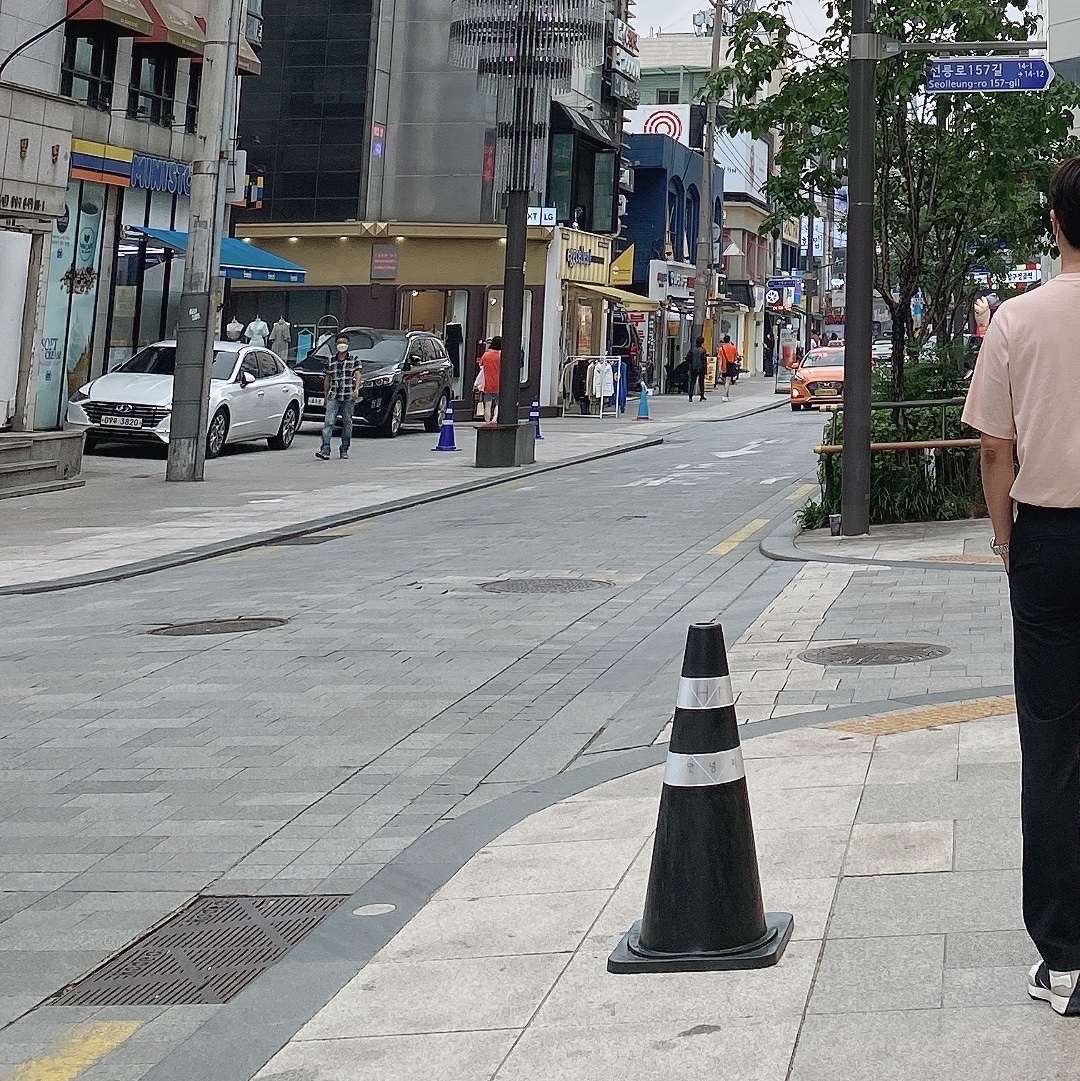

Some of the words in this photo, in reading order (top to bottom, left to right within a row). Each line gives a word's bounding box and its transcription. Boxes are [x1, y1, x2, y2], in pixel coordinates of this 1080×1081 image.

[930, 62, 1003, 78] 선릉로157길
[1024, 70, 1045, 78] 14-12
[928, 79, 988, 89] Seolleung-ro
[990, 78, 1021, 88] 157-gil
[131, 154, 192, 197] MINISTO
[543, 213, 554, 221] LG
[120, 417, 139, 427] 3820
